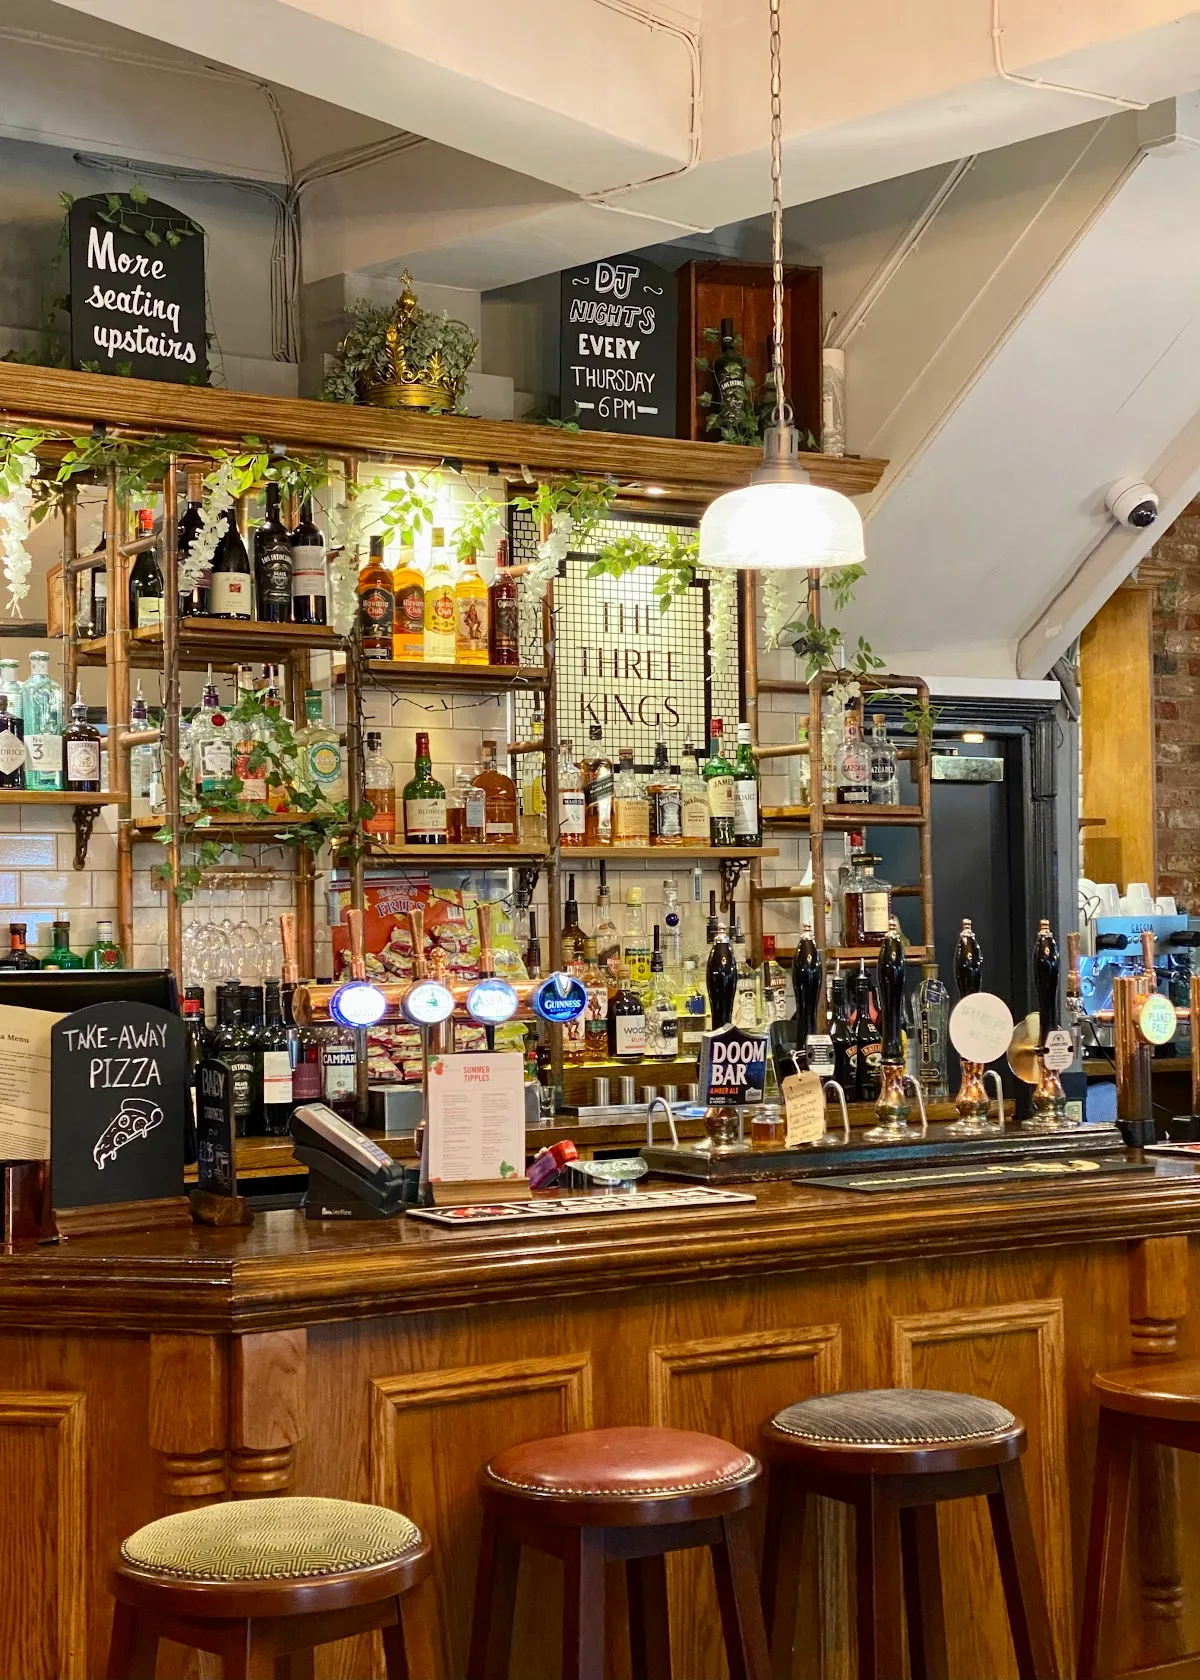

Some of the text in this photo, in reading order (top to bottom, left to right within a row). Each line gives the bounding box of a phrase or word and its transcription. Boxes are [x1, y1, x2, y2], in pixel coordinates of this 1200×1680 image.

[87, 226, 167, 279] More
[595, 262, 640, 299] DJ
[84, 284, 180, 333] seating
[569, 299, 656, 334] NIGHTS
[93, 325, 197, 364] upstairs
[578, 333, 640, 360] EVERY
[570, 366, 656, 394] THURSDAY
[408, 606, 422, 614] Club
[597, 601, 662, 636] THE
[372, 624, 379, 632] 7
[576, 646, 683, 682] THREE
[580, 692, 680, 728] KINGS
[33, 744, 44, 760] 3
[871, 766, 894, 774] AZCABEL
[377, 885, 418, 899] BACON
[545, 1000, 581, 1009] GUINNESS
[7, 1034, 30, 1044] Menu
[62, 1022, 167, 1052] TAKE-AWAY
[1152, 1023, 1168, 1033] PALE
[712, 1041, 766, 1064] DOOM
[89, 1057, 162, 1088] PIZZA
[463, 1066, 490, 1074] SUMMER
[464, 1074, 490, 1082] TIPPLES
[711, 1063, 748, 1086] BAR
[202, 1067, 225, 1099] BABY
[710, 1087, 739, 1095] AMBER ALE
